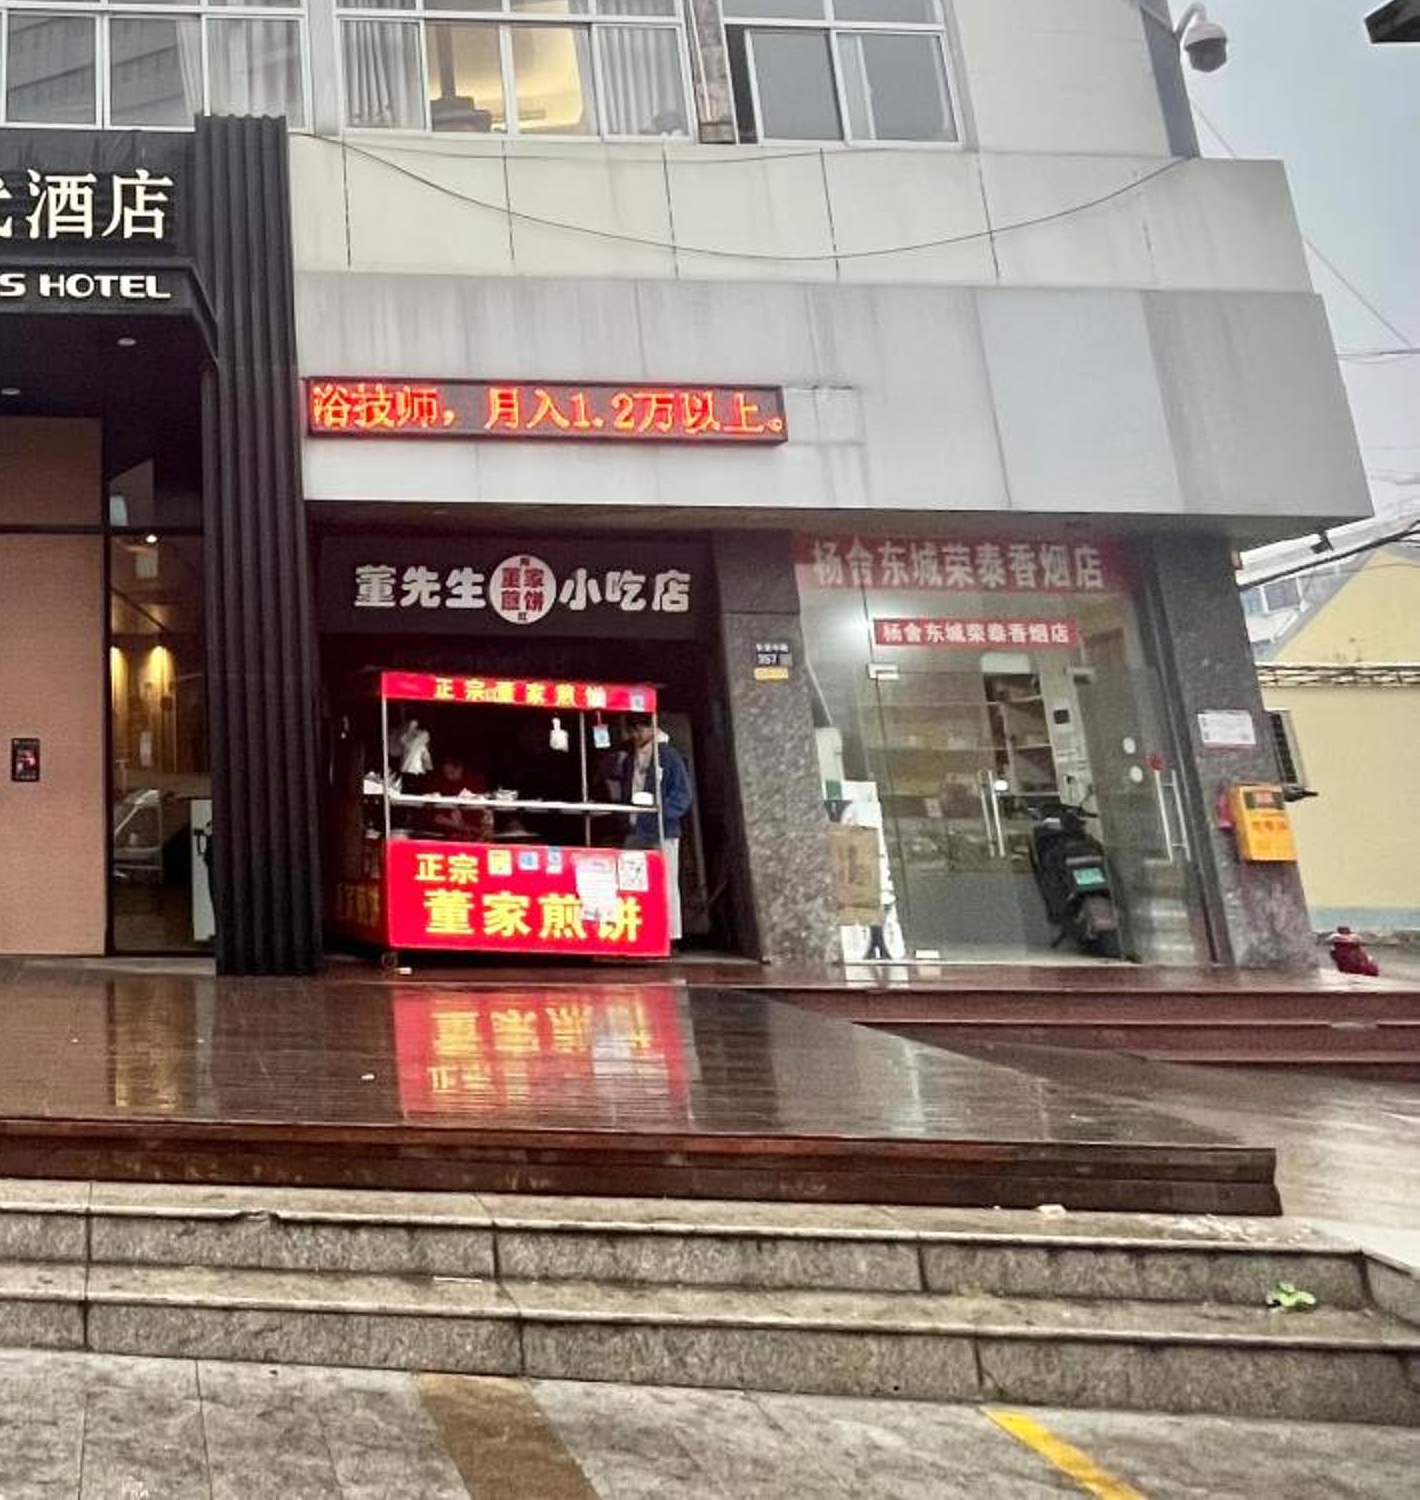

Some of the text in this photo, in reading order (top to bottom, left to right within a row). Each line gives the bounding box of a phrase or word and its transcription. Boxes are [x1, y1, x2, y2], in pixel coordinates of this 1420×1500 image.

[39, 273, 172, 300] HOTEL
[353, 564, 692, 613] 董先生 小吃店
[414, 852, 479, 885] 正宗
